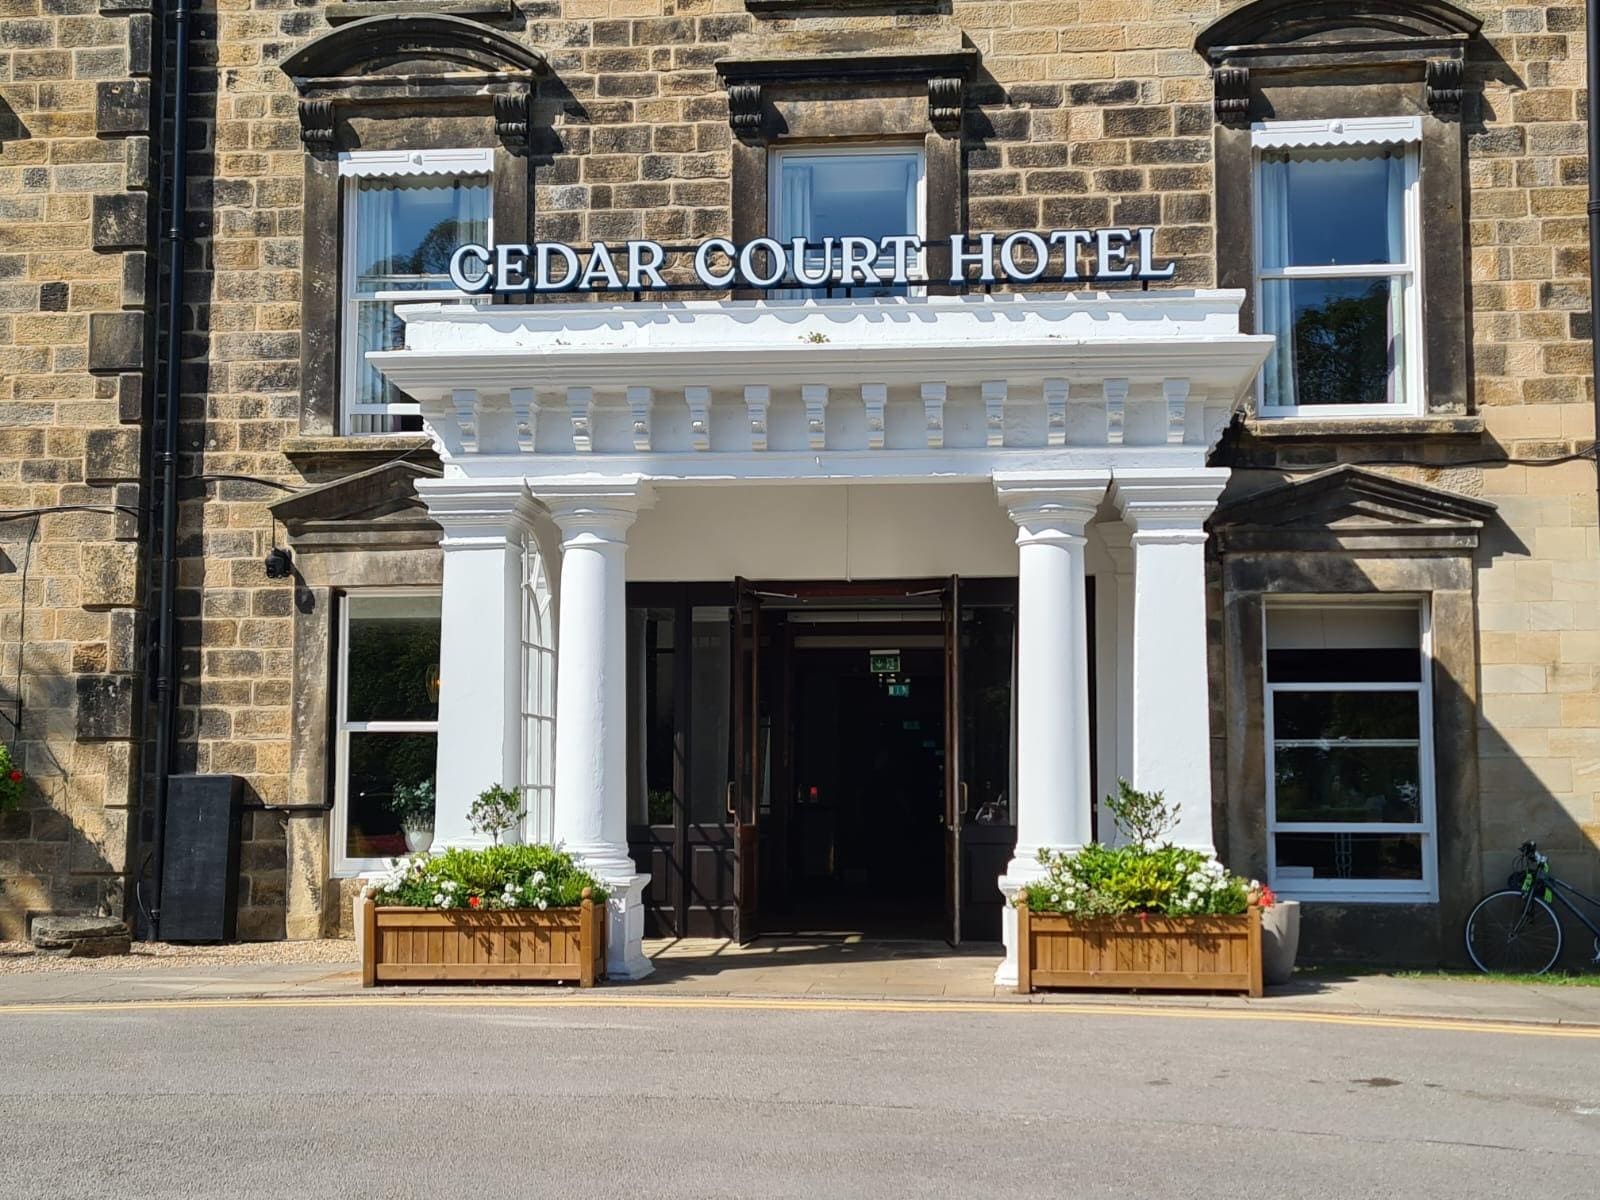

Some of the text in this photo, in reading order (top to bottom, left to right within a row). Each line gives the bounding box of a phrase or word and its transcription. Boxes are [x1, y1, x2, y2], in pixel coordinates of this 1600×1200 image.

[448, 227, 1176, 293] CEDAR COURT HOTEL
